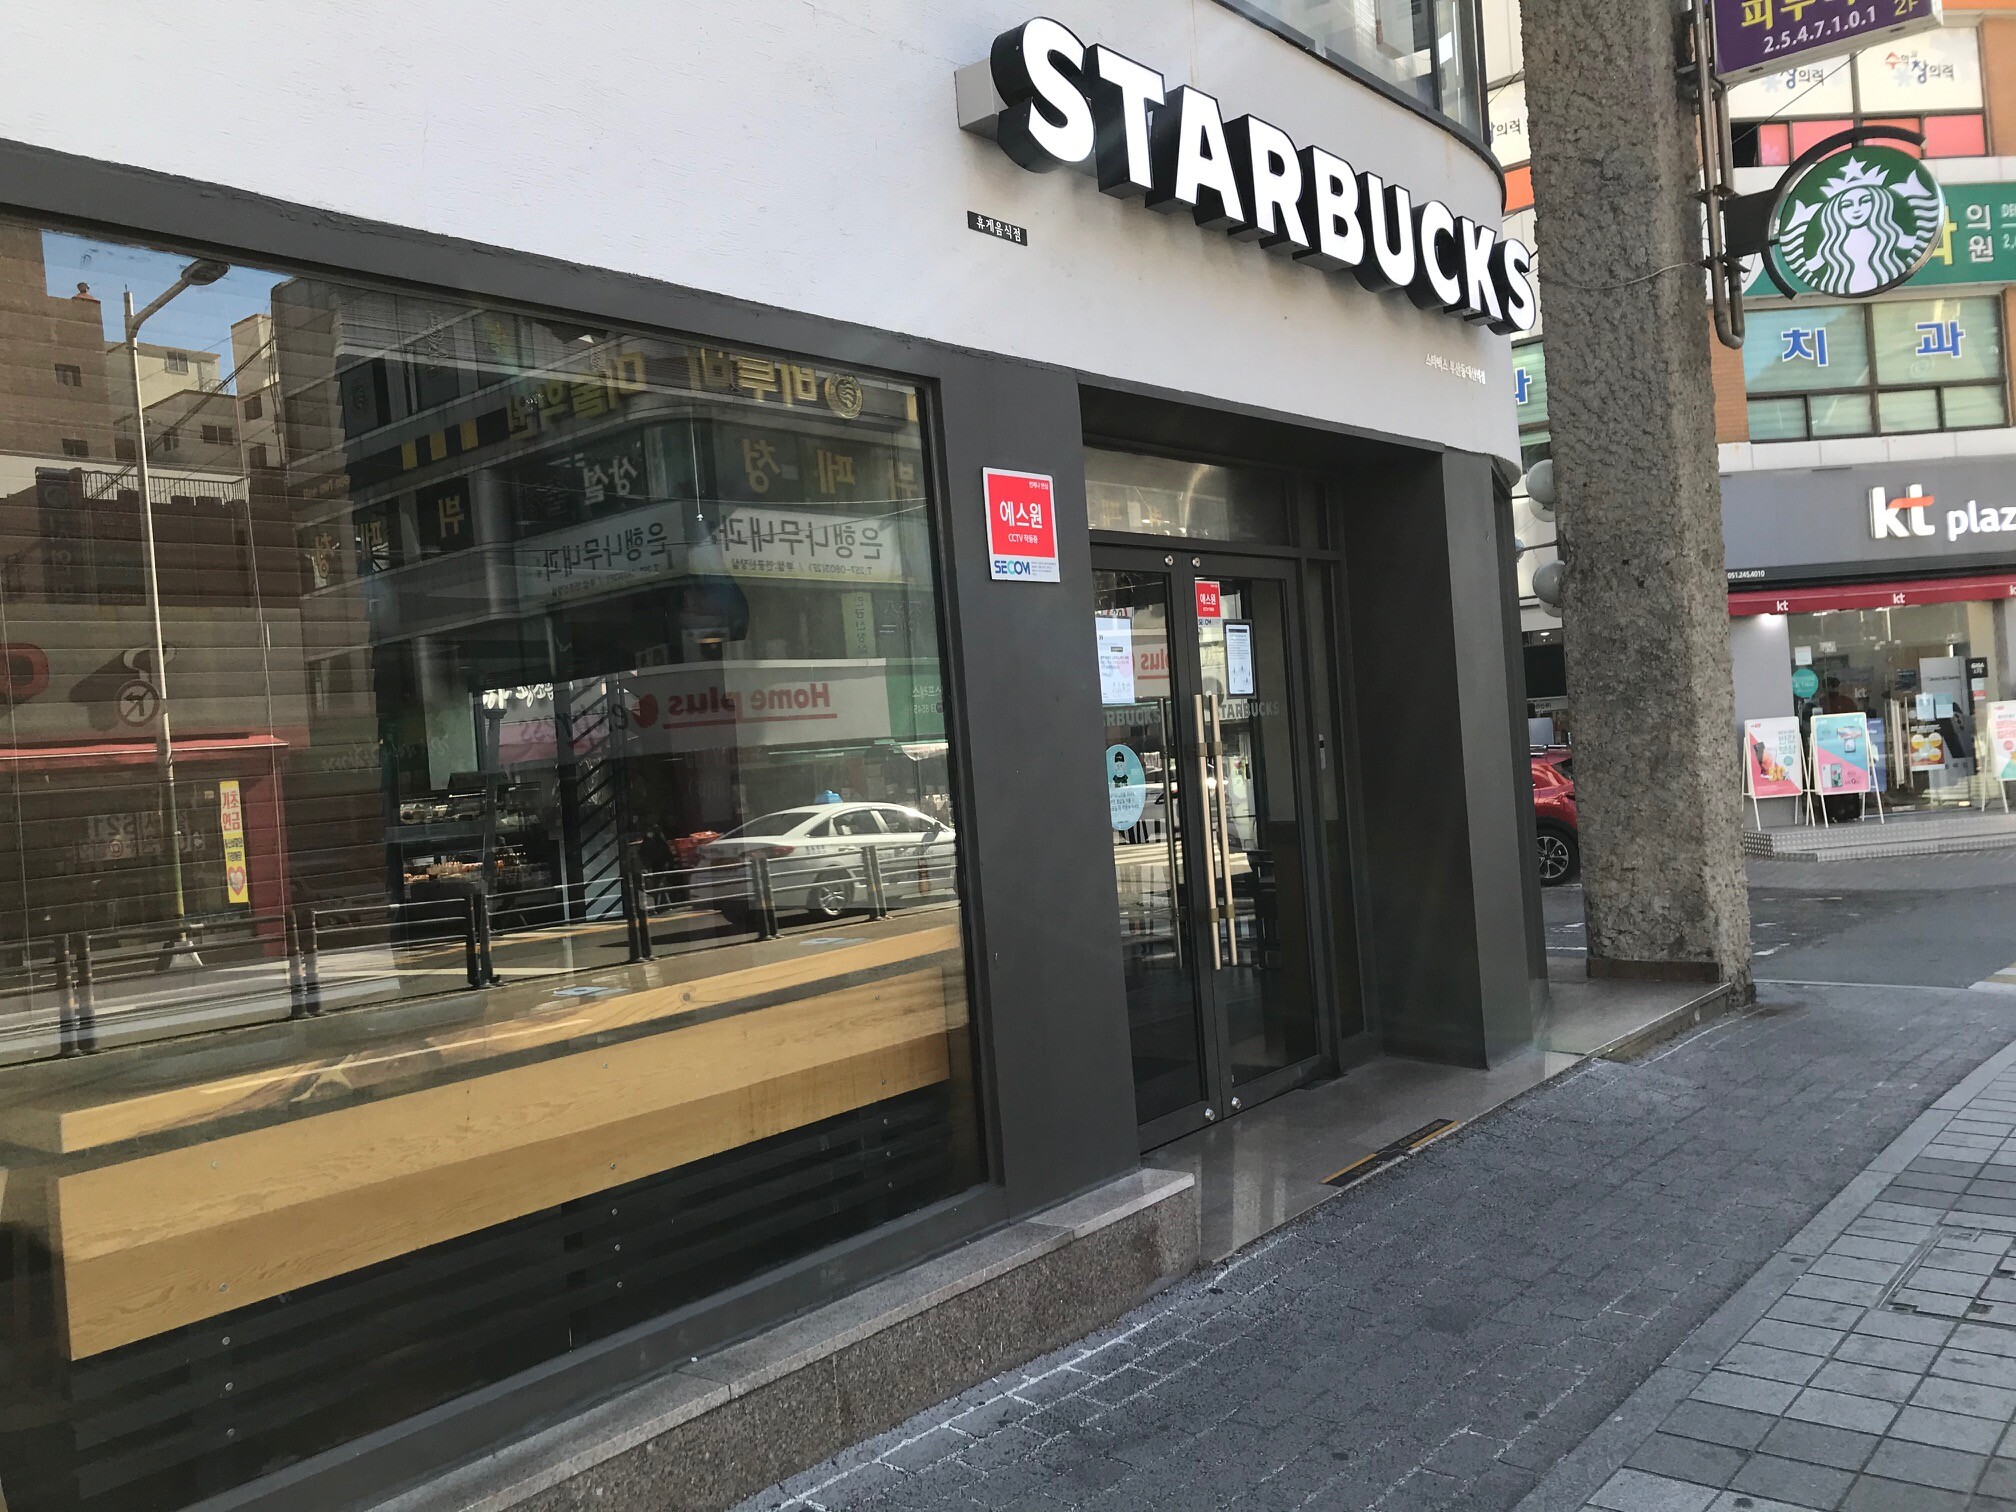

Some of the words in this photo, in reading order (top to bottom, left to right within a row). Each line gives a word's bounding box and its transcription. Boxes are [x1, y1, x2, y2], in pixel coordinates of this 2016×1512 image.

[1763, 5, 1876, 54] 2.5.4.7.1.0.1
[1020, 17, 1536, 332] STARBUCKS
[977, 215, 1022, 242] 휴게음식점
[1425, 353, 1449, 371] 스타벅스
[1000, 500, 1043, 529] 에스원
[1869, 484, 1935, 538] kt
[1008, 533, 1024, 543] CCTV
[994, 560, 1031, 576] SECOM
[1728, 570, 1766, 580] 051.245.4010
[1200, 593, 1217, 606] 에스원
[1776, 600, 1789, 612] kt
[1893, 593, 1906, 604] kt
[1104, 709, 1161, 727] RBUCKS
